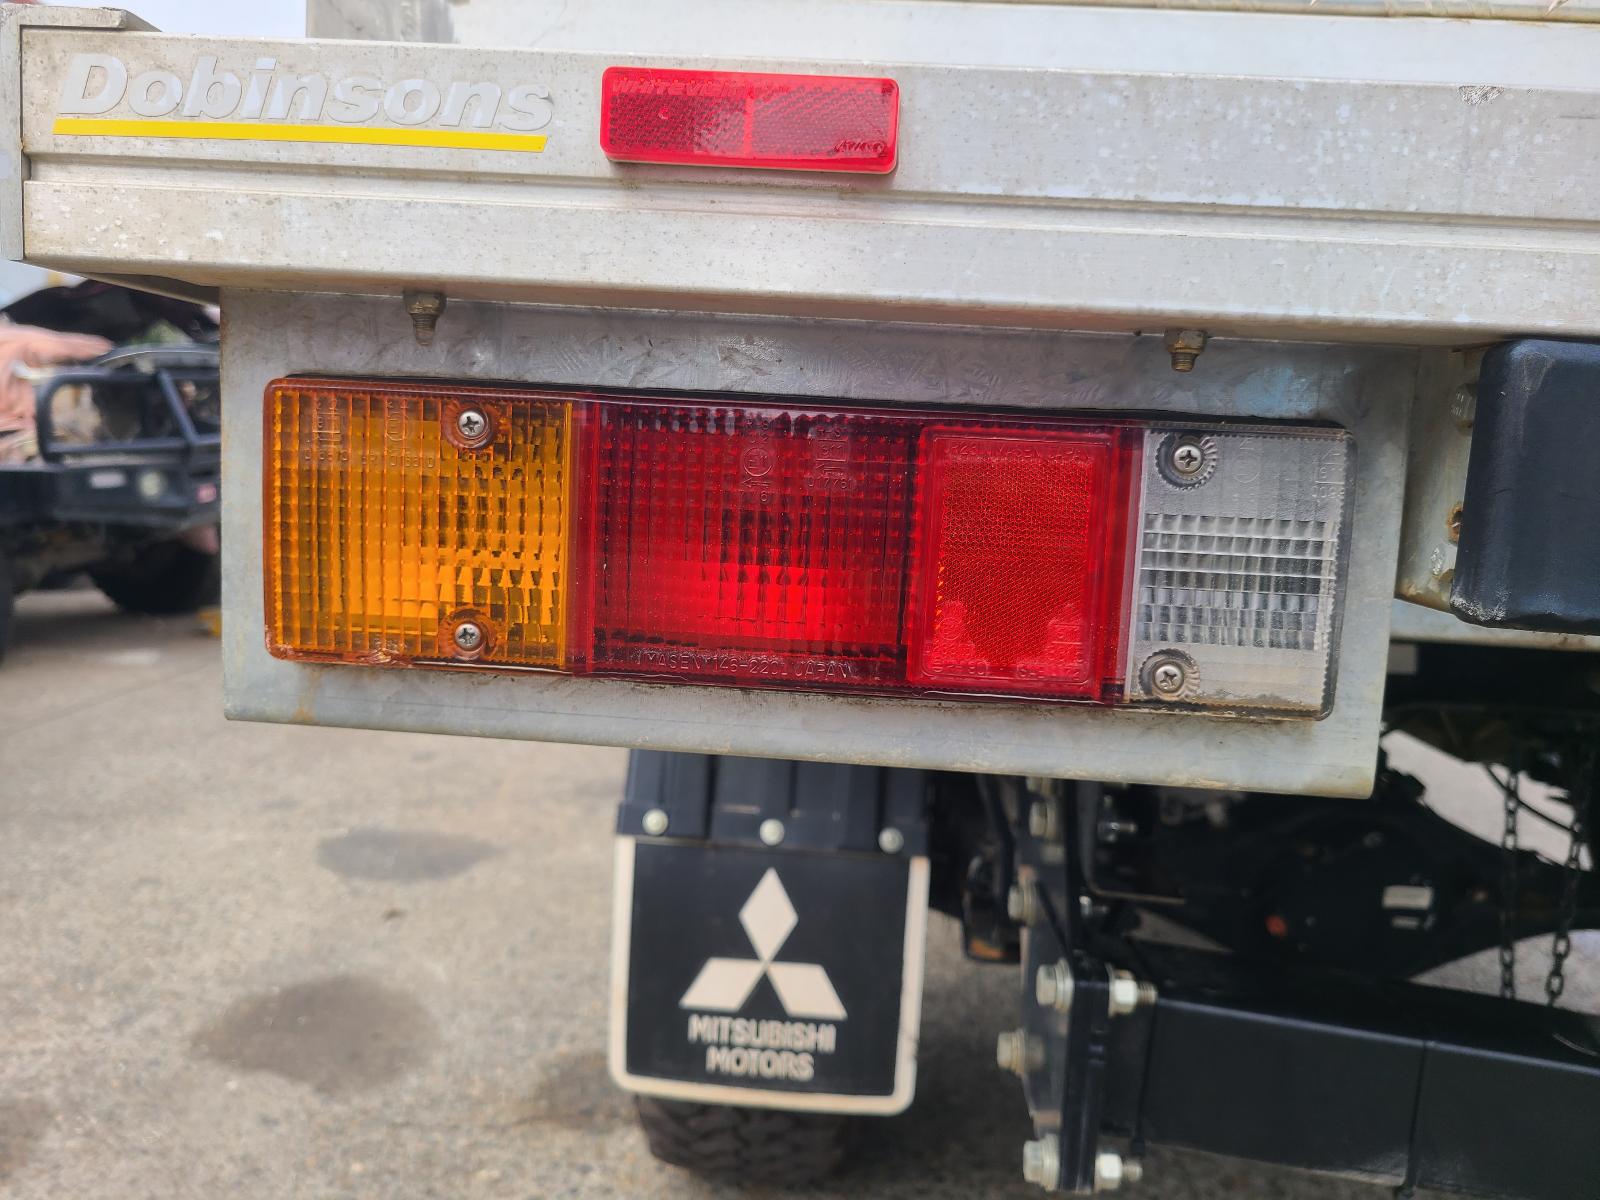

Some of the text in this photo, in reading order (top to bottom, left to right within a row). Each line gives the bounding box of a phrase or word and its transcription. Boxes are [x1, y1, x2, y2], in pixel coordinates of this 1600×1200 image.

[58, 52, 553, 132] Dobinsons
[687, 1013, 837, 1054] MITSUBISHI
[706, 1045, 815, 1081] MOTORS
